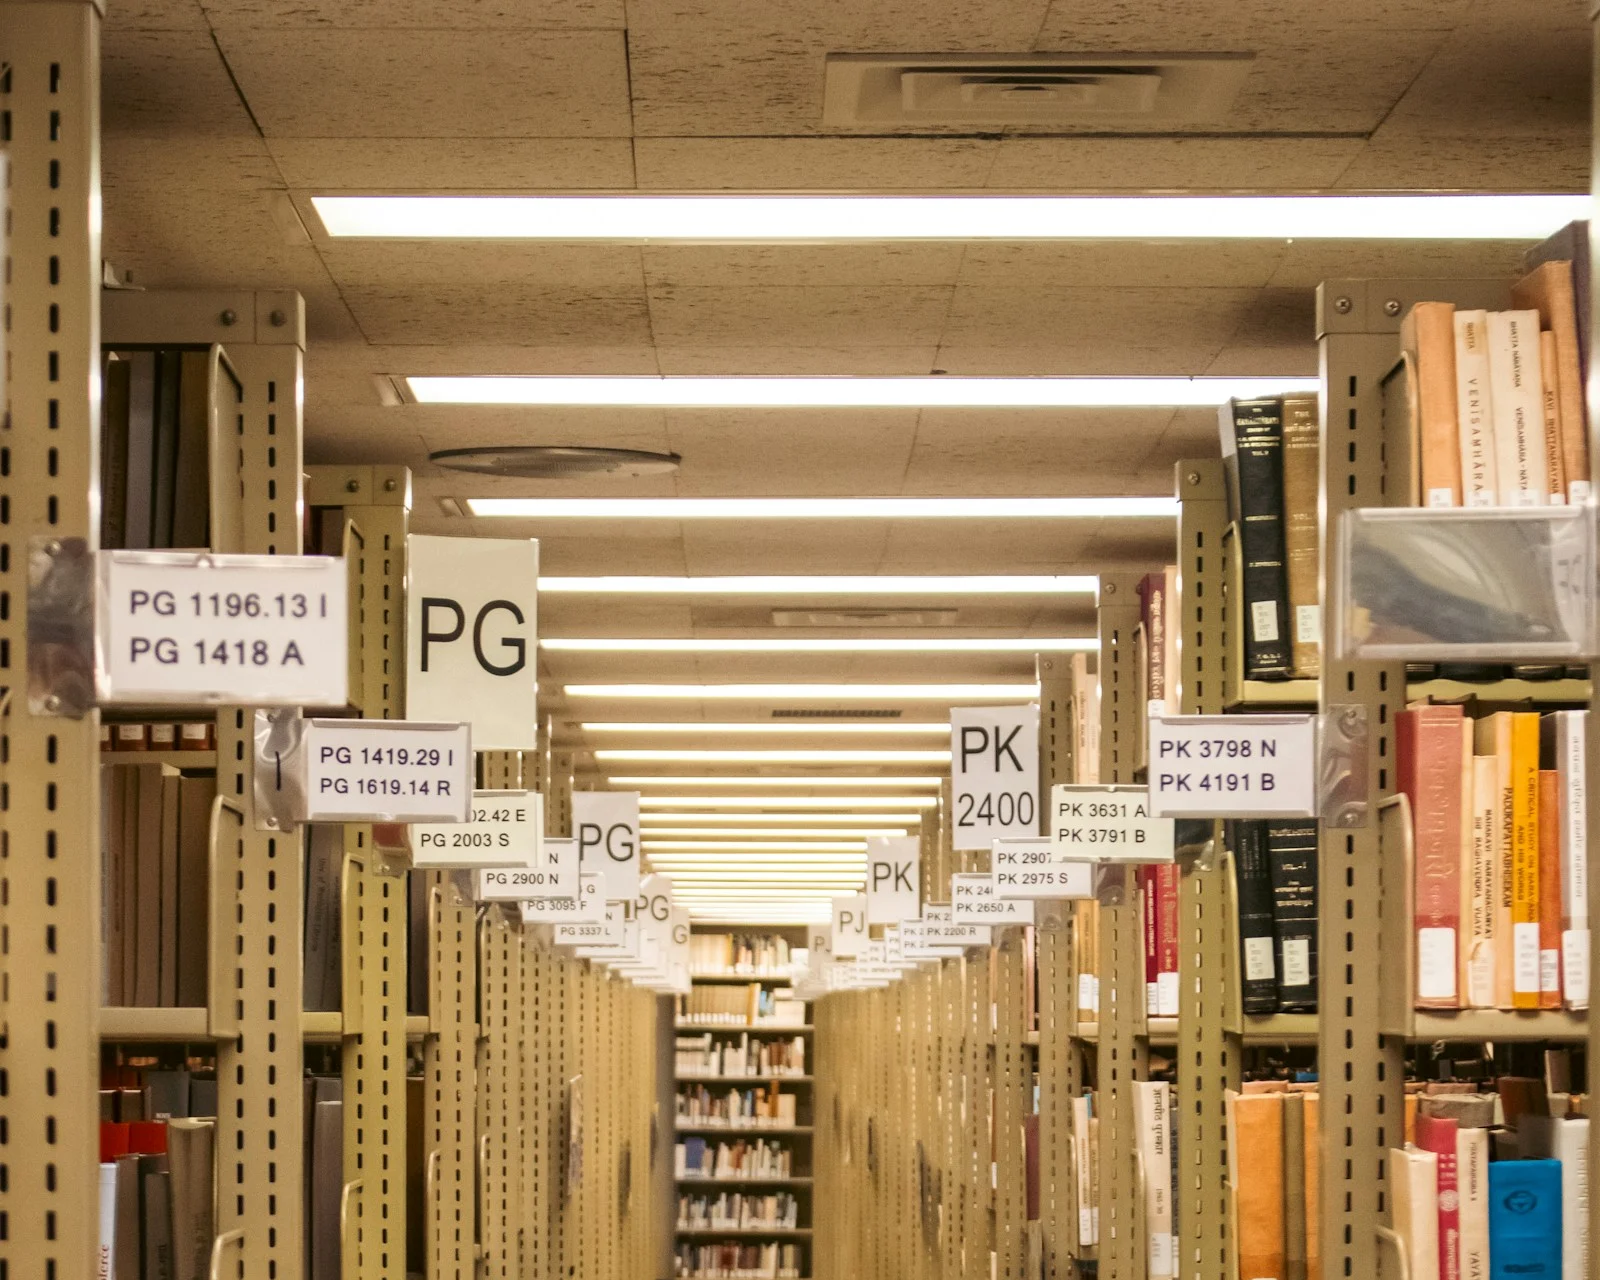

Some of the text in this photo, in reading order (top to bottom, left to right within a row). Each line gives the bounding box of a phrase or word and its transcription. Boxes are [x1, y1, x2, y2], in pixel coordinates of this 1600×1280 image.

[131, 590, 326, 618] PG 1196.13 I
[421, 597, 525, 676] PG
[131, 637, 303, 665] PG 1418 A
[321, 747, 452, 766] PG 1419.29 I
[961, 725, 1023, 773] PK
[1161, 740, 1275, 757] PK 3798 N
[321, 778, 450, 795] PG 1619.14 R
[1161, 773, 1274, 791] PK 4191 B
[1526, 777, 1535, 818] CRITICAL
[473, 809, 525, 822] 2.42 E
[958, 792, 1033, 826] 2400
[1060, 803, 1149, 818] PK 3631 A
[421, 833, 509, 847] PG 2003 S
[579, 823, 633, 864] PG
[1060, 829, 1145, 843] PK 3791 B
[1517, 825, 1525, 844] AND
[1527, 821, 1536, 851] STUDY
[550, 853, 558, 863] N
[998, 853, 1017, 863] PK
[487, 873, 558, 884] PG 2900 N
[874, 862, 913, 892] PK
[999, 873, 1067, 884] PK 2975 S
[1516, 868, 1526, 901] WORKS
[957, 886, 993, 895] PK 24
[527, 901, 587, 911] PG 3095 F
[631, 895, 669, 922] PG
[957, 903, 1015, 912] PK 2650 A
[560, 927, 576, 935] PG
[579, 927, 601, 935] 3337
[840, 911, 864, 933] PJ
[673, 924, 688, 944] G
[814, 936, 831, 953] P
